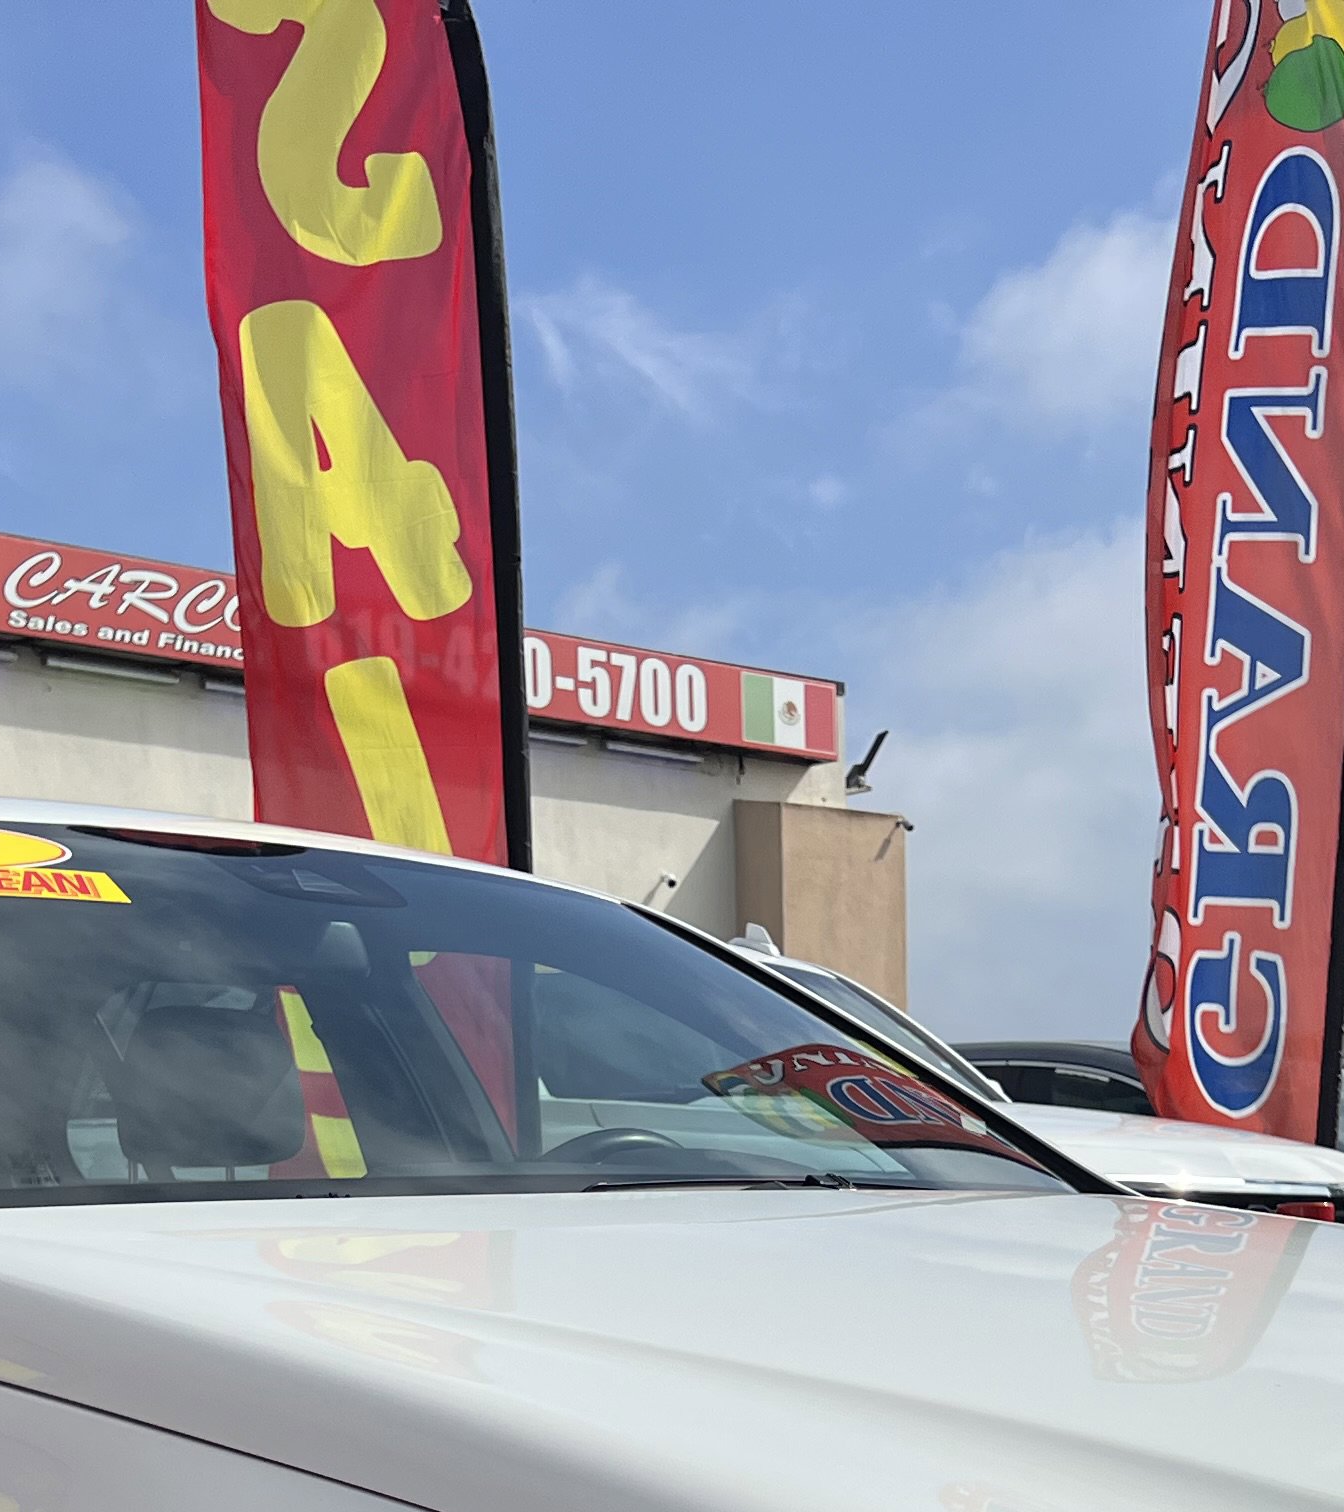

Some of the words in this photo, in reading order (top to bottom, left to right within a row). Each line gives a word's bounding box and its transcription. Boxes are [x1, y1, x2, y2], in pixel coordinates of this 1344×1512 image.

[8, 609, 88, 636] Sales
[97, 625, 150, 646] and
[158, 632, 244, 660] Financ
